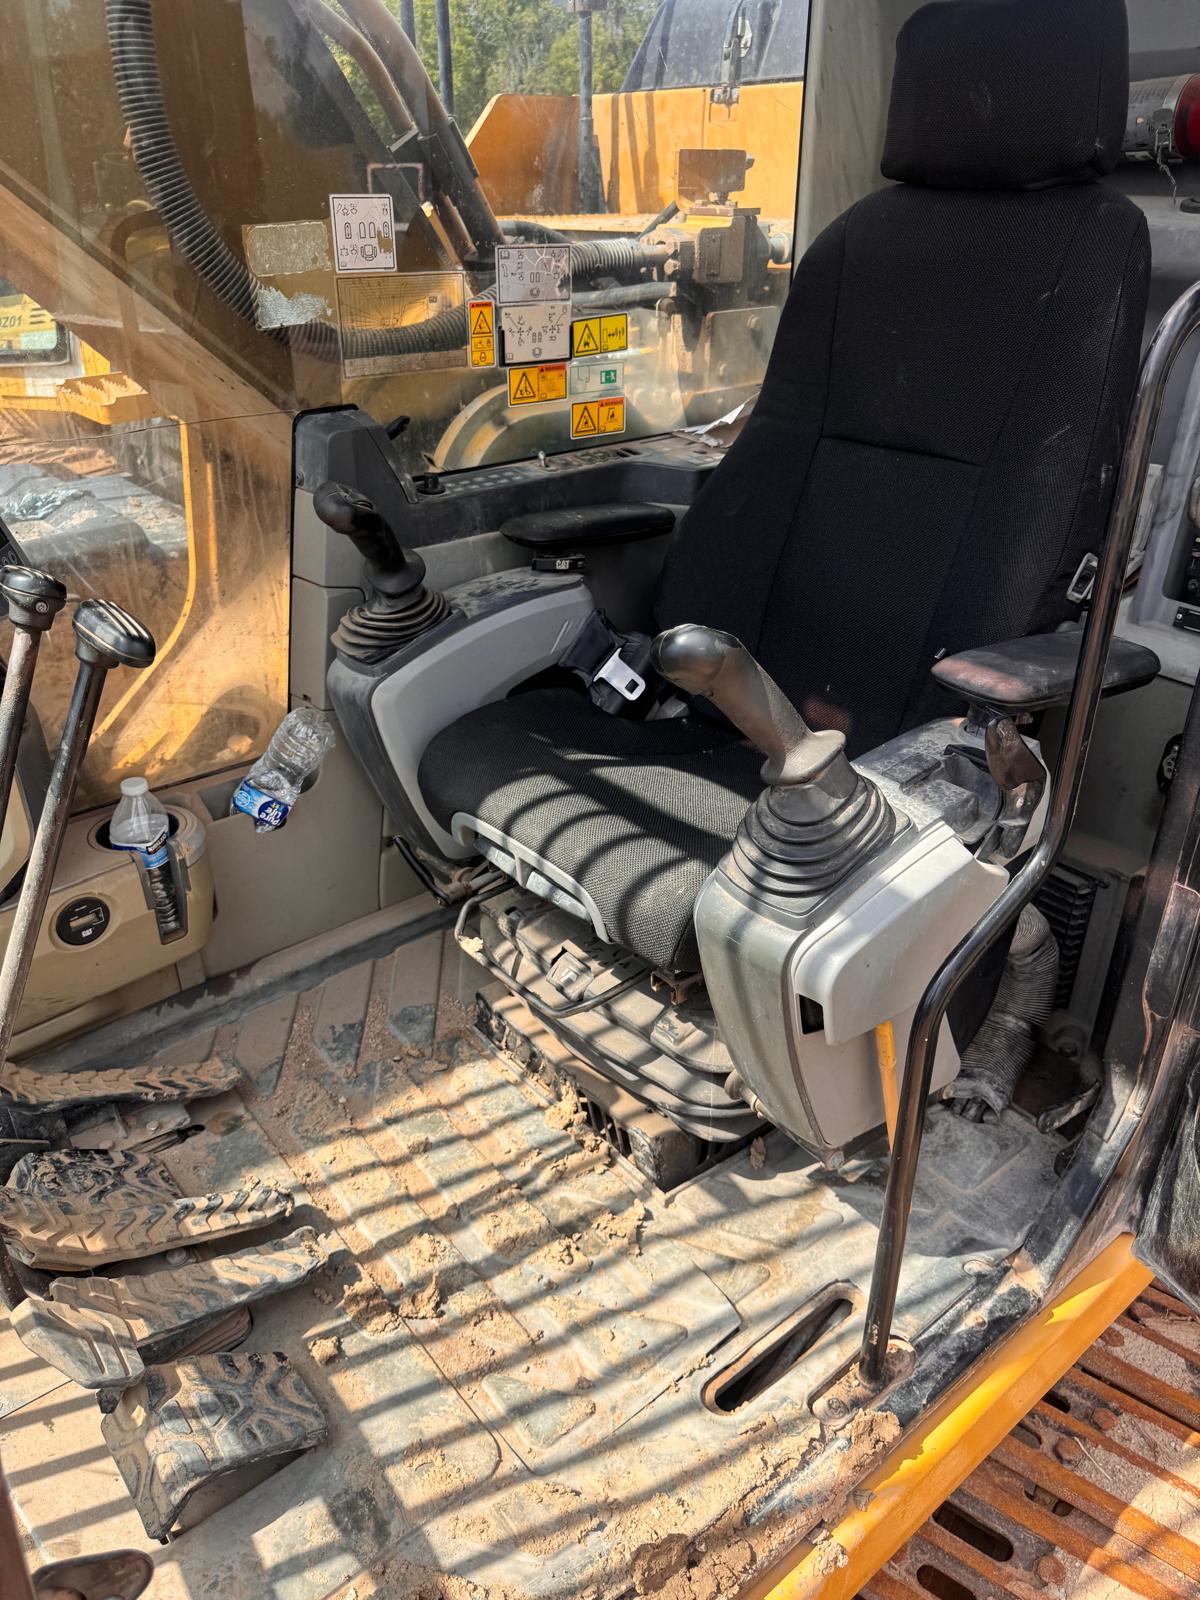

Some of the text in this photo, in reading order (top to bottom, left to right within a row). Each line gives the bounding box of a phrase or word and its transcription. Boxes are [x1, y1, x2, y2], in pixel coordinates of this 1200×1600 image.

[0, 315, 22, 328] Z01
[556, 559, 570, 570] CAT
[259, 812, 281, 826] Pure
[264, 806, 282, 819] Life
